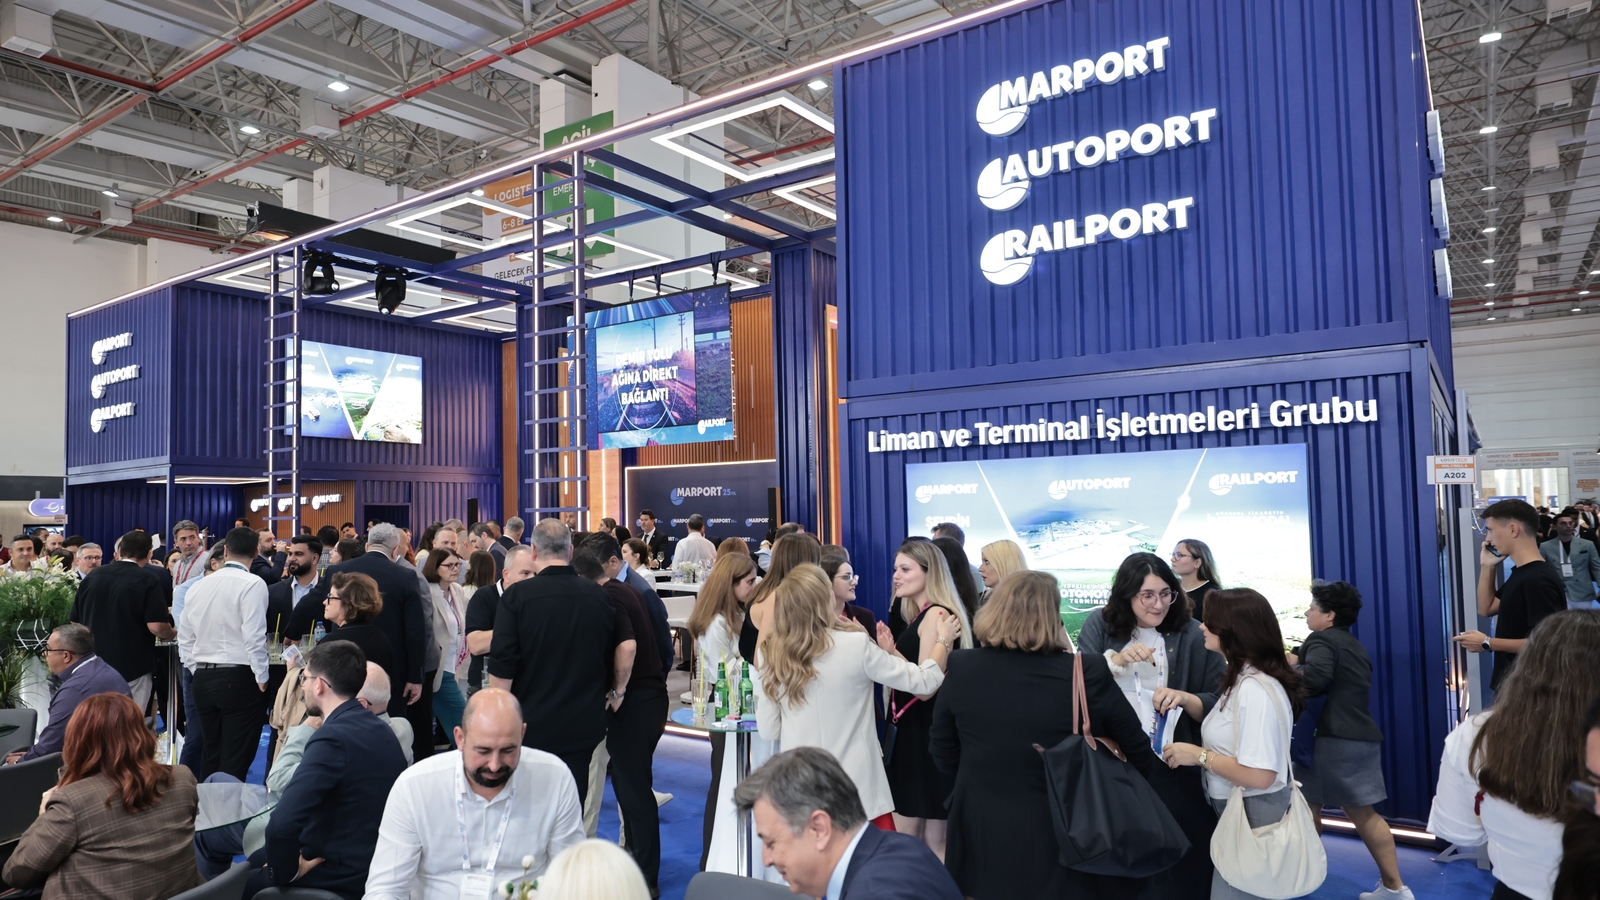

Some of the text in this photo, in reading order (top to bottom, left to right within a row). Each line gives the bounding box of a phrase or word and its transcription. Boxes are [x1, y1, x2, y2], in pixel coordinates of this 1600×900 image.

[999, 36, 1170, 111] MARPORT
[1002, 108, 1217, 184] AUTOPORT
[494, 184, 532, 202] LOGISTE
[1004, 196, 1194, 259] RAILPORT
[494, 266, 525, 280] GELECEK
[647, 346, 672, 361] YOLU
[611, 365, 679, 387] AĞINA DİREKT
[621, 387, 669, 405] BAĞLANTI
[868, 396, 1379, 453] Liman ve Terminal İşletmeleri Grubu
[1057, 477, 1132, 491] AUTOPORT
[1219, 470, 1298, 485] RAILPORT
[676, 486, 722, 497] MARPORT
[923, 483, 979, 495] MARPORT
[1060, 588, 1110, 599] OTOMOT
